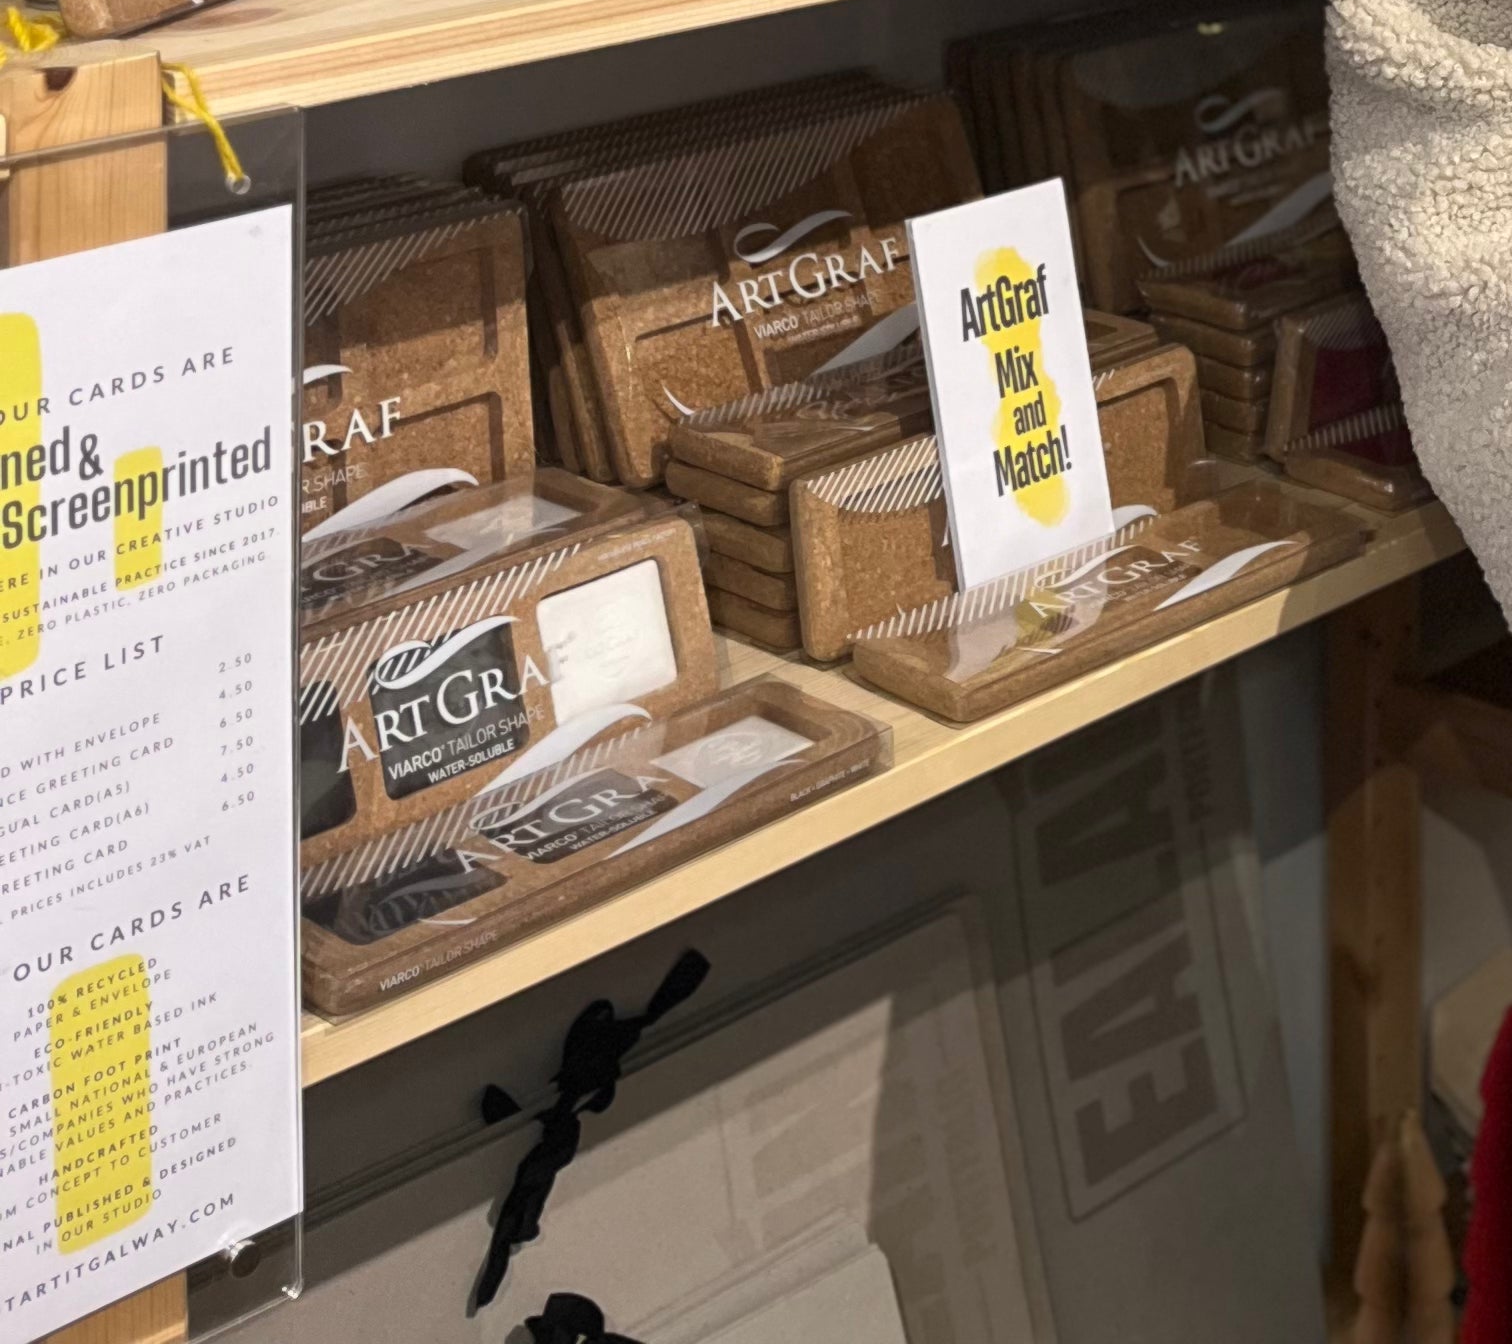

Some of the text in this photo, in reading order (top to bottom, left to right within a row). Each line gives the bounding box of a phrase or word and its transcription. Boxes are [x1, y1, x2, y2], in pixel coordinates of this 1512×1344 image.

[754, 314, 799, 340] VIARCO
[959, 263, 1050, 343] ArtGraf
[68, 365, 165, 407] CARDS
[180, 346, 235, 377] ARE
[993, 345, 1039, 399] Mix
[1012, 391, 1047, 436] and
[78, 432, 105, 481] &
[992, 424, 1073, 497] Match!
[1, 425, 272, 550] Screenprinted
[39, 564, 59, 581] IN
[68, 549, 107, 571] OUR
[115, 519, 204, 557] CREATIVE
[213, 495, 279, 526] STUDIO
[2, 581, 108, 624] SUSTAINABLE
[114, 556, 187, 589] PRACTICE
[193, 540, 236, 564] SINCE
[17, 618, 57, 642] ZERO
[138, 580, 177, 603] ZERO
[0, 634, 165, 706] PRICE LIST
[217, 653, 253, 674] 2.50
[218, 680, 254, 701] 4.50
[20, 712, 161, 773] WITH ENVELOPE
[219, 708, 254, 729] 6.50
[220, 735, 255, 758] 7.50
[387, 703, 546, 781] VIARCO TAILOR SHAPE
[36, 736, 175, 796] GREETING CARD
[221, 763, 256, 785] 4.50
[426, 737, 517, 786] WATER-SOLUBLE
[49, 780, 131, 820] CARD(A5)
[69, 801, 150, 842] CARD(A6)
[221, 790, 256, 813] 6.50
[1, 839, 129, 896] REETING CARD
[11, 834, 213, 921] PRICES INCLUDES 23% VAT
[12, 873, 251, 983] OUR CARDS ARE
[13, 968, 173, 1043] PAPER & ENVELOPE
[27, 957, 158, 1018] 100% RECYCLED
[379, 965, 421, 993] VIARCO
[34, 1000, 155, 1060] ECO-FRIENDLY
[70, 1030, 126, 1062] WATER
[132, 1006, 183, 1036] BASED
[191, 992, 219, 1012] INK
[8, 1037, 183, 1120] CARBON FOOT PRINT
[9, 1022, 259, 1138] SMALL NATIONAL & EUROPEAN
[121, 1081, 160, 1107] WHO
[166, 1061, 208, 1087] HAVE
[213, 1030, 276, 1066] STRONG
[38, 1124, 160, 1186] HANDCRAFTED
[55, 1118, 116, 1153] VALUES
[123, 1100, 157, 1123] AND
[26, 1112, 223, 1210] CONCEPT TO CUSTOMER
[43, 1183, 135, 1234] PUBLISHED
[141, 1176, 152, 1189] &
[158, 1136, 238, 1180] DESIGNED
[36, 1188, 163, 1256] IN OUR STUDIO
